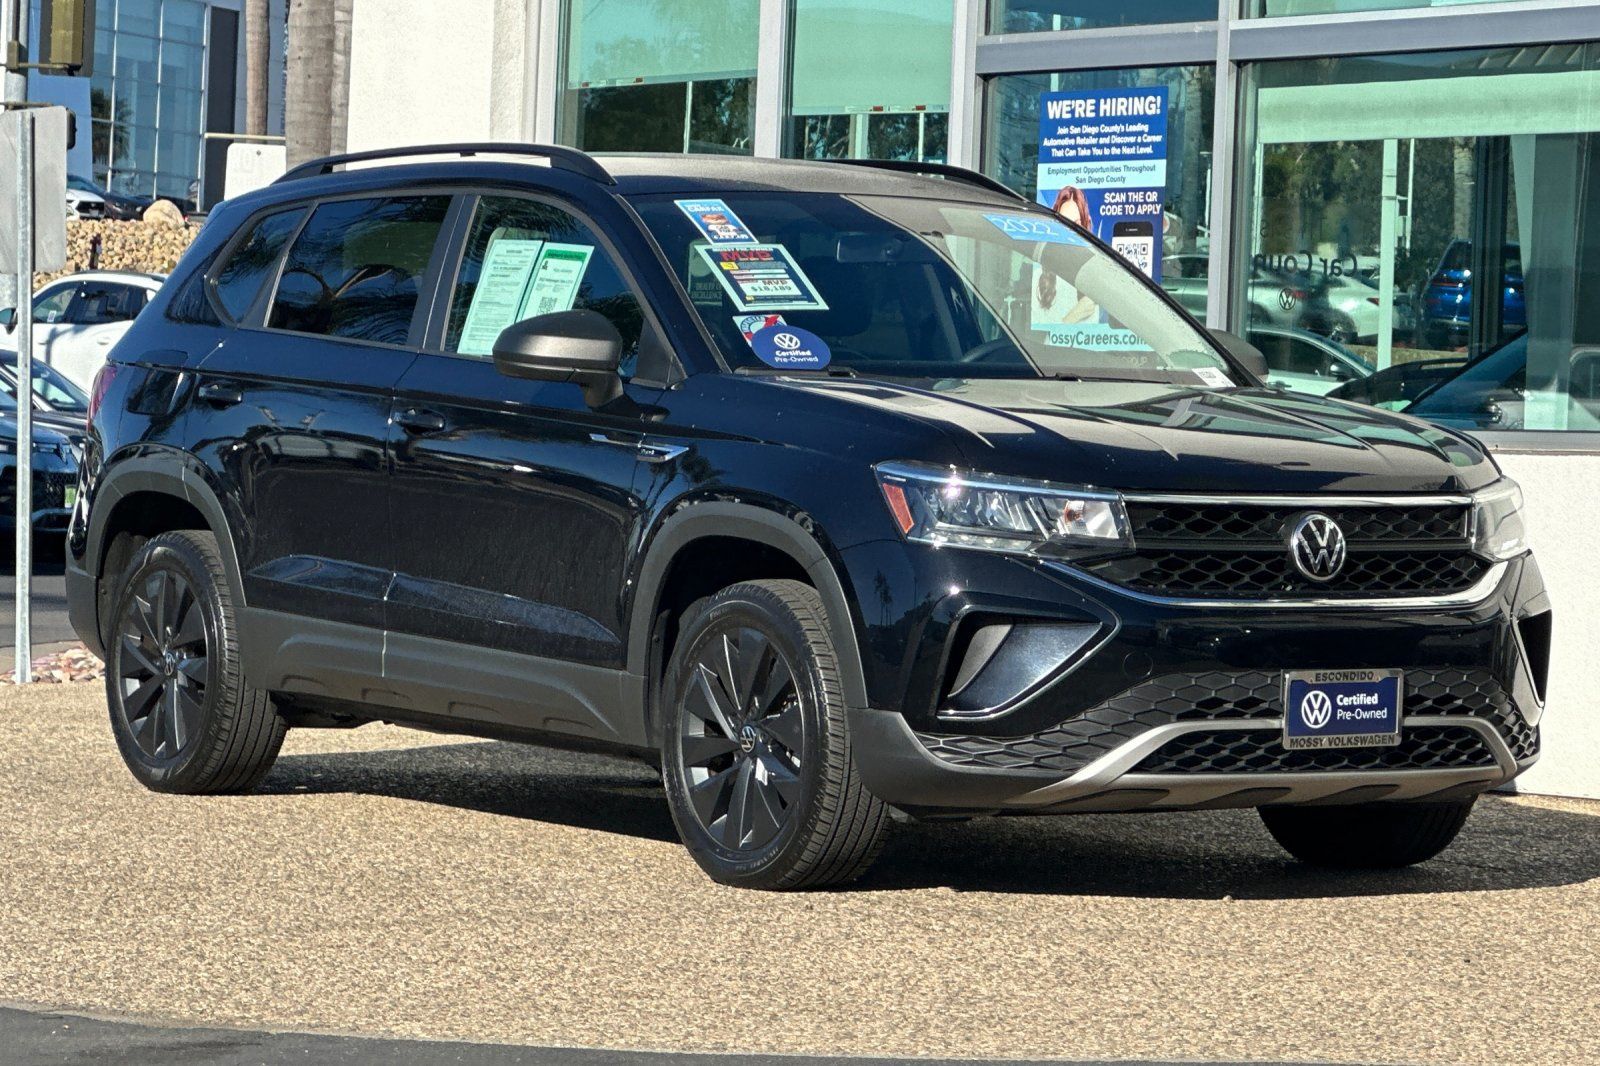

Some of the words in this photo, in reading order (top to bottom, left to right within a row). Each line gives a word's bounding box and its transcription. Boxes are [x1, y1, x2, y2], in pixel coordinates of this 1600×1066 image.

[1047, 99, 1096, 119] WE'RE
[1100, 96, 1162, 118] HIRING!
[1057, 126, 1069, 135] Join
[1070, 125, 1081, 134] San
[1082, 124, 1099, 135] Diego
[1100, 124, 1124, 134] County's
[1126, 123, 1149, 132] Leading
[1043, 137, 1075, 146] Automotive
[1076, 136, 1098, 145] Retailer
[1099, 135, 1110, 144] and
[1111, 135, 1136, 144] Discover
[1142, 134, 1162, 142] Career
[1051, 148, 1064, 157] That
[1065, 148, 1077, 156] Can
[1077, 147, 1091, 156] Take
[1092, 147, 1103, 155] You
[1103, 147, 1110, 155] to
[1111, 146, 1121, 155] the
[1122, 146, 1136, 154] Next
[1047, 167, 1081, 175] Employment
[1083, 165, 1121, 174] Opportunities
[1123, 164, 1156, 173] Throughout
[1075, 176, 1086, 184] San
[1088, 176, 1104, 185] Diego
[1106, 175, 1126, 183] County
[1104, 192, 1126, 203] SCAN
[1127, 191, 1144, 202] THE
[1145, 191, 1158, 202] QR
[1100, 205, 1122, 216] CODE
[1124, 205, 1135, 215] TO
[1136, 204, 1162, 215] APPLY
[1315, 671, 1374, 681] ESCONDIDO
[1336, 692, 1378, 706] Certified
[1337, 707, 1388, 720] Pre-Owned
[1290, 737, 1326, 748] MOSSY
[1328, 734, 1395, 746] VOLKSWAGEN
